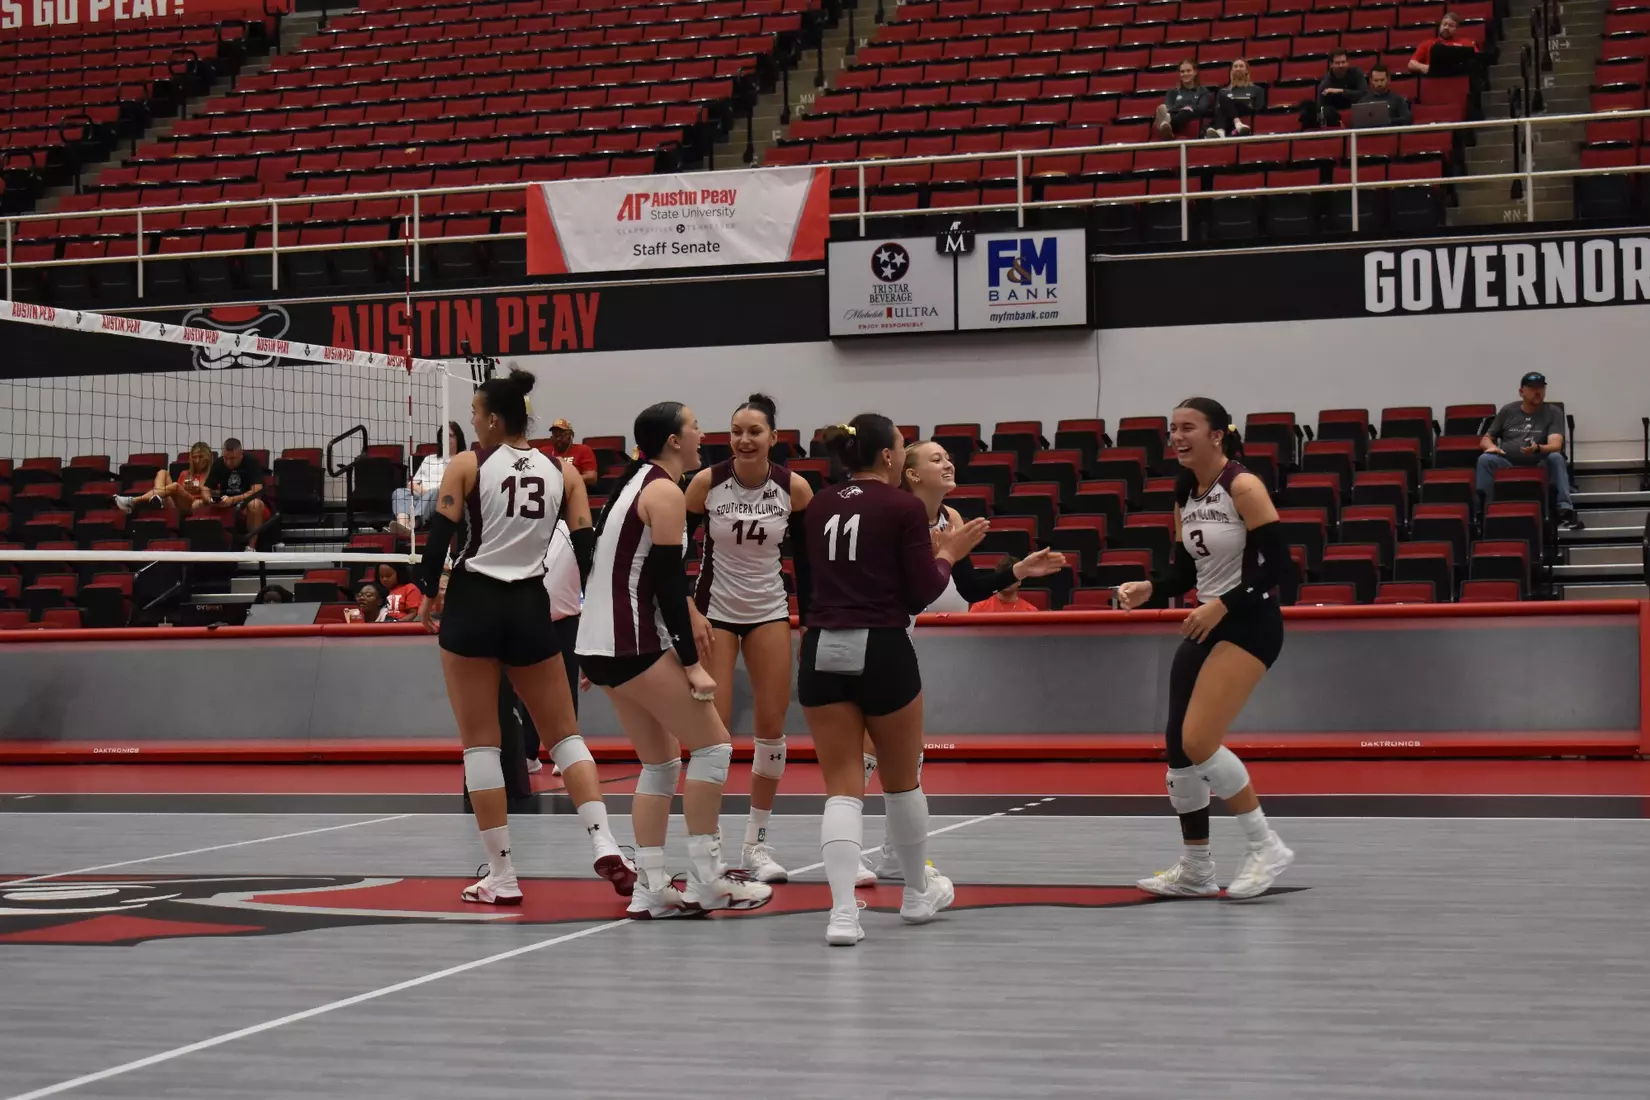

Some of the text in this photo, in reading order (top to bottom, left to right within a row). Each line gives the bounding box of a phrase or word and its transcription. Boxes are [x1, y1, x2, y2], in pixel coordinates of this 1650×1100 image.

[33, 0, 79, 27] GO
[90, 0, 185, 22] PEAY!
[651, 189, 737, 208] Austin Peay
[650, 206, 736, 221] State University
[633, 240, 720, 257] Staff Senate
[944, 234, 967, 253] M
[988, 237, 1058, 287] F&M
[1364, 237, 1650, 313] GOVERNOR
[888, 283, 909, 294] STAR
[988, 287, 1058, 302] BANK
[869, 292, 913, 304] BEVERAGE
[12, 302, 38, 319] AUSTIN
[894, 306, 939, 318] ULTRA
[989, 309, 1059, 324] myfmbank.com
[331, 292, 600, 357] AUSTIN PEAY
[880, 321, 925, 329] RESPONSIBLY
[501, 475, 546, 520] 13
[716, 502, 754, 516] SOUTHERN
[732, 519, 768, 546] 14
[823, 514, 861, 562] 11
[1190, 529, 1211, 557] 3
